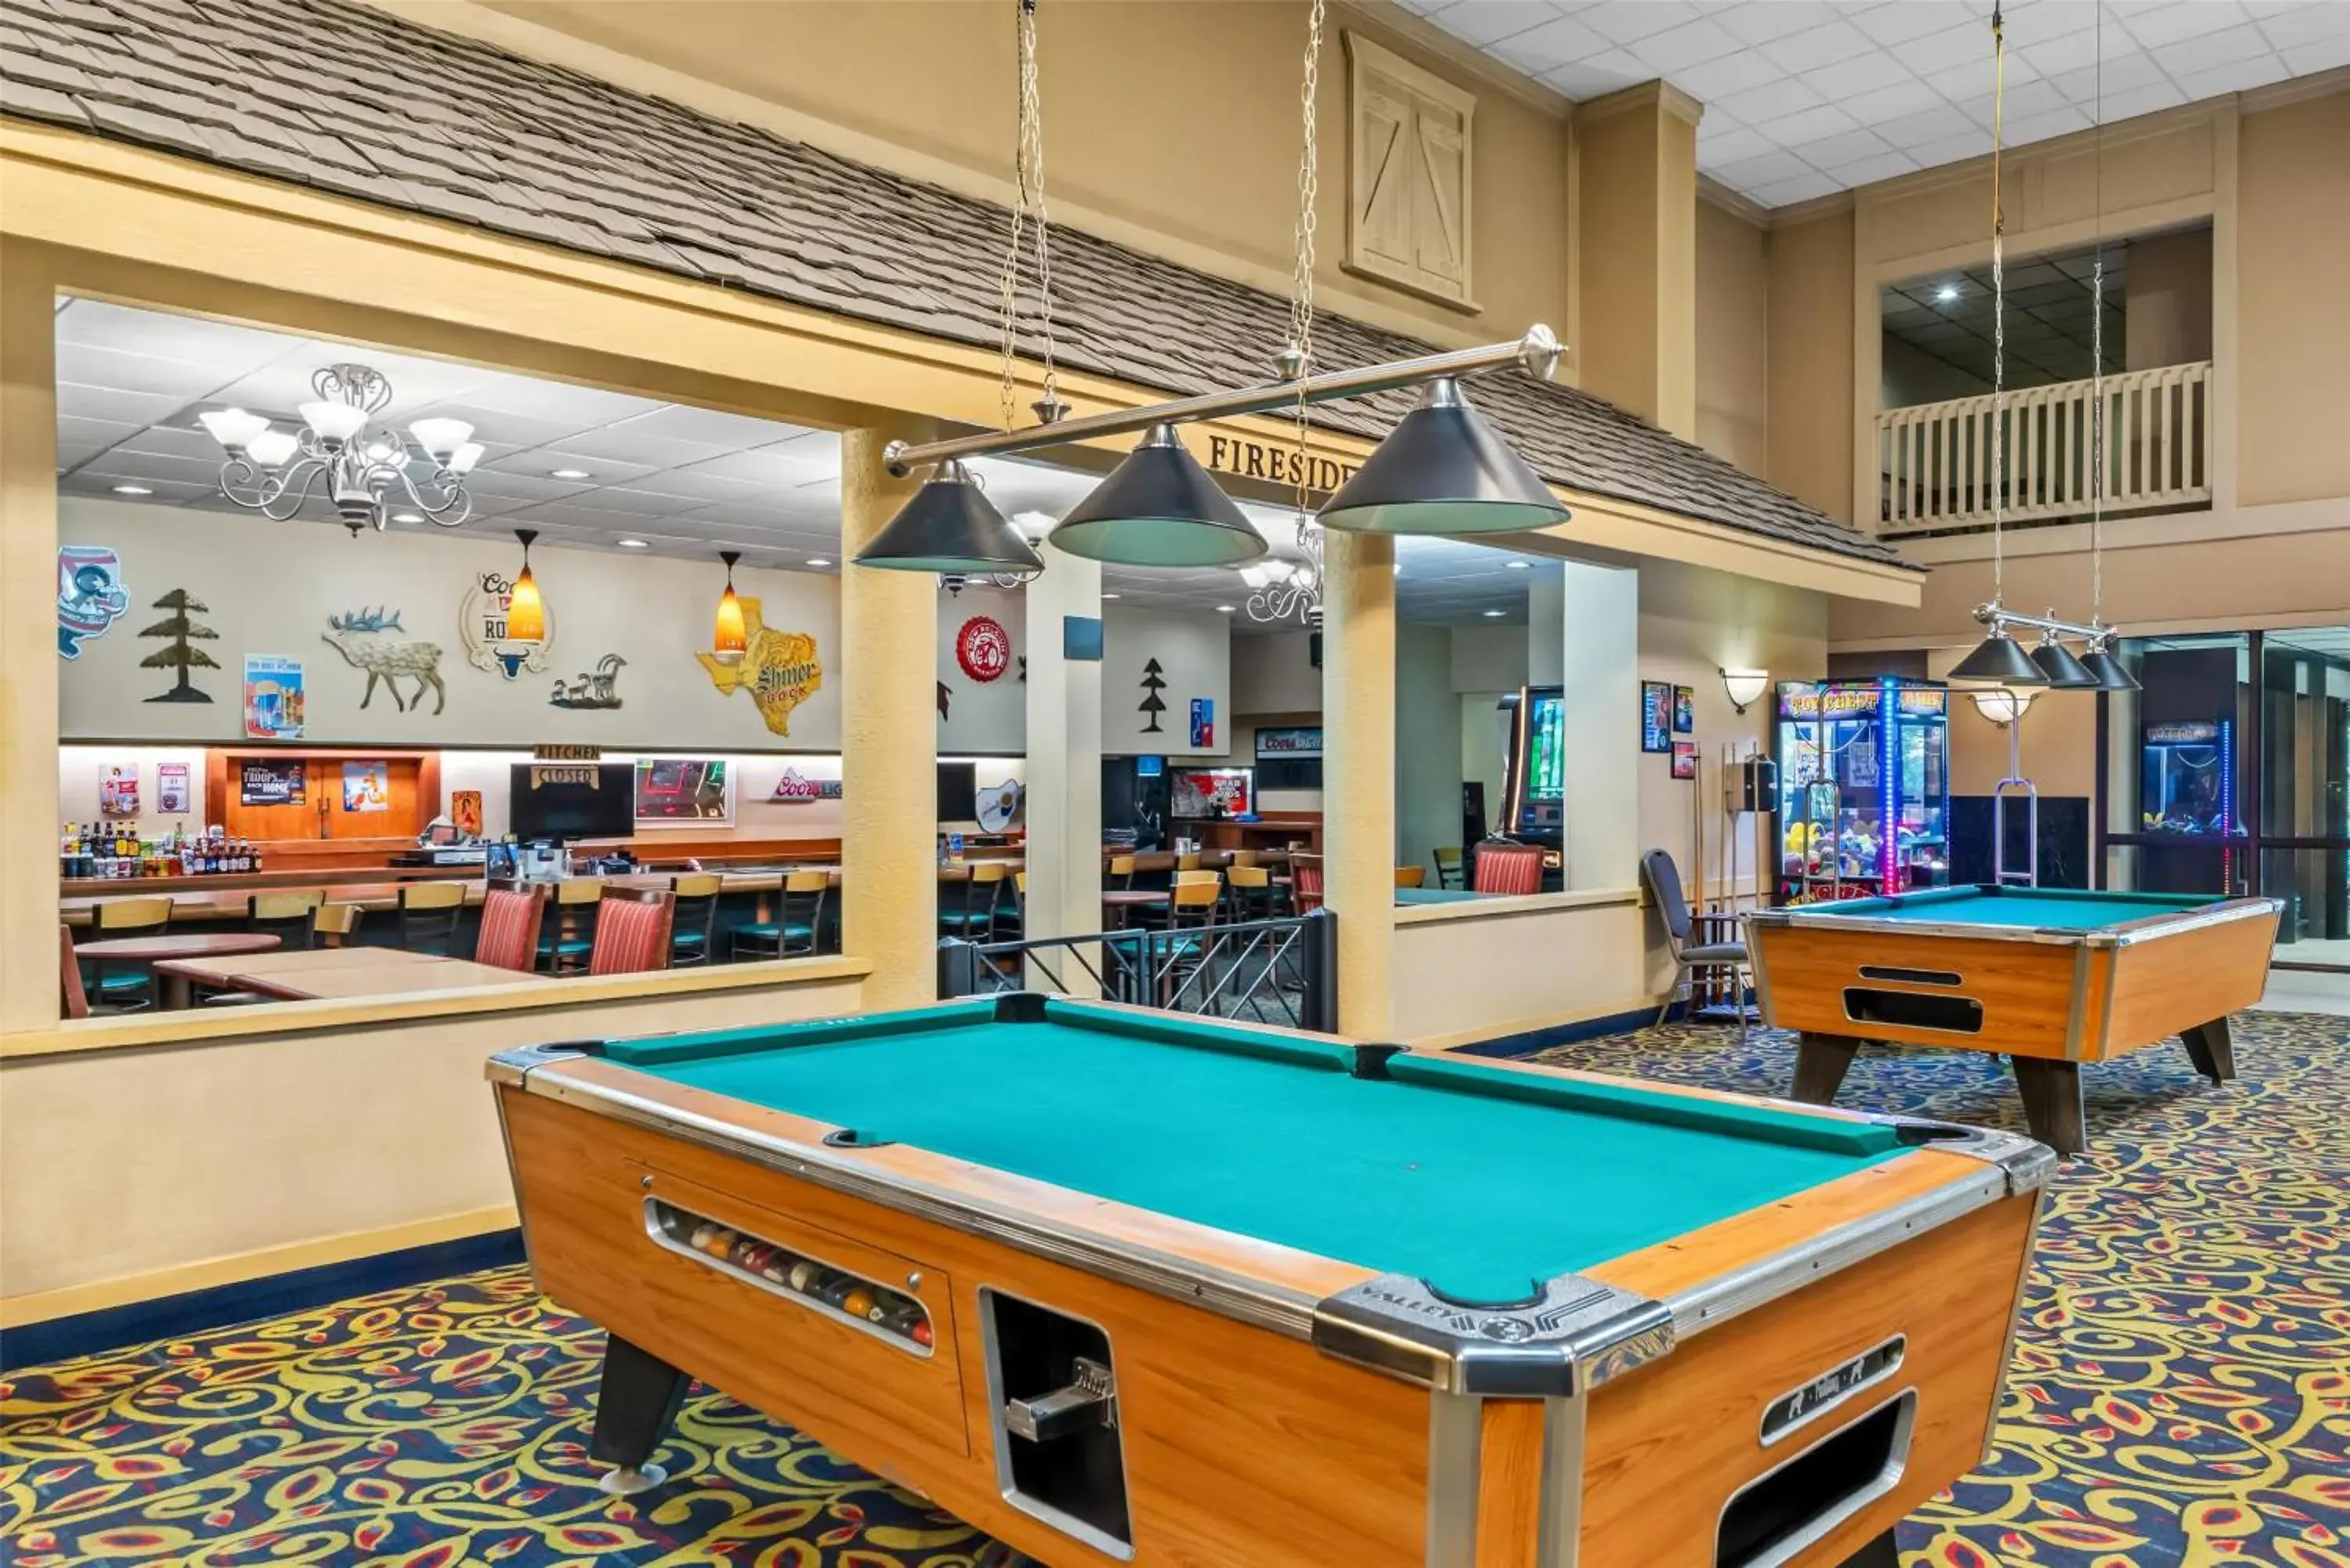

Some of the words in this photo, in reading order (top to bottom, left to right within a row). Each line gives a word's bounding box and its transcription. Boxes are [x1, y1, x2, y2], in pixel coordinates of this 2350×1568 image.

[538, 744, 601, 760] KITCHEN
[538, 768, 591, 782] CLOSED
[776, 776, 820, 797] Coors
[822, 782, 843, 796] LIG
[1362, 1286, 1452, 1317] VALLEY
